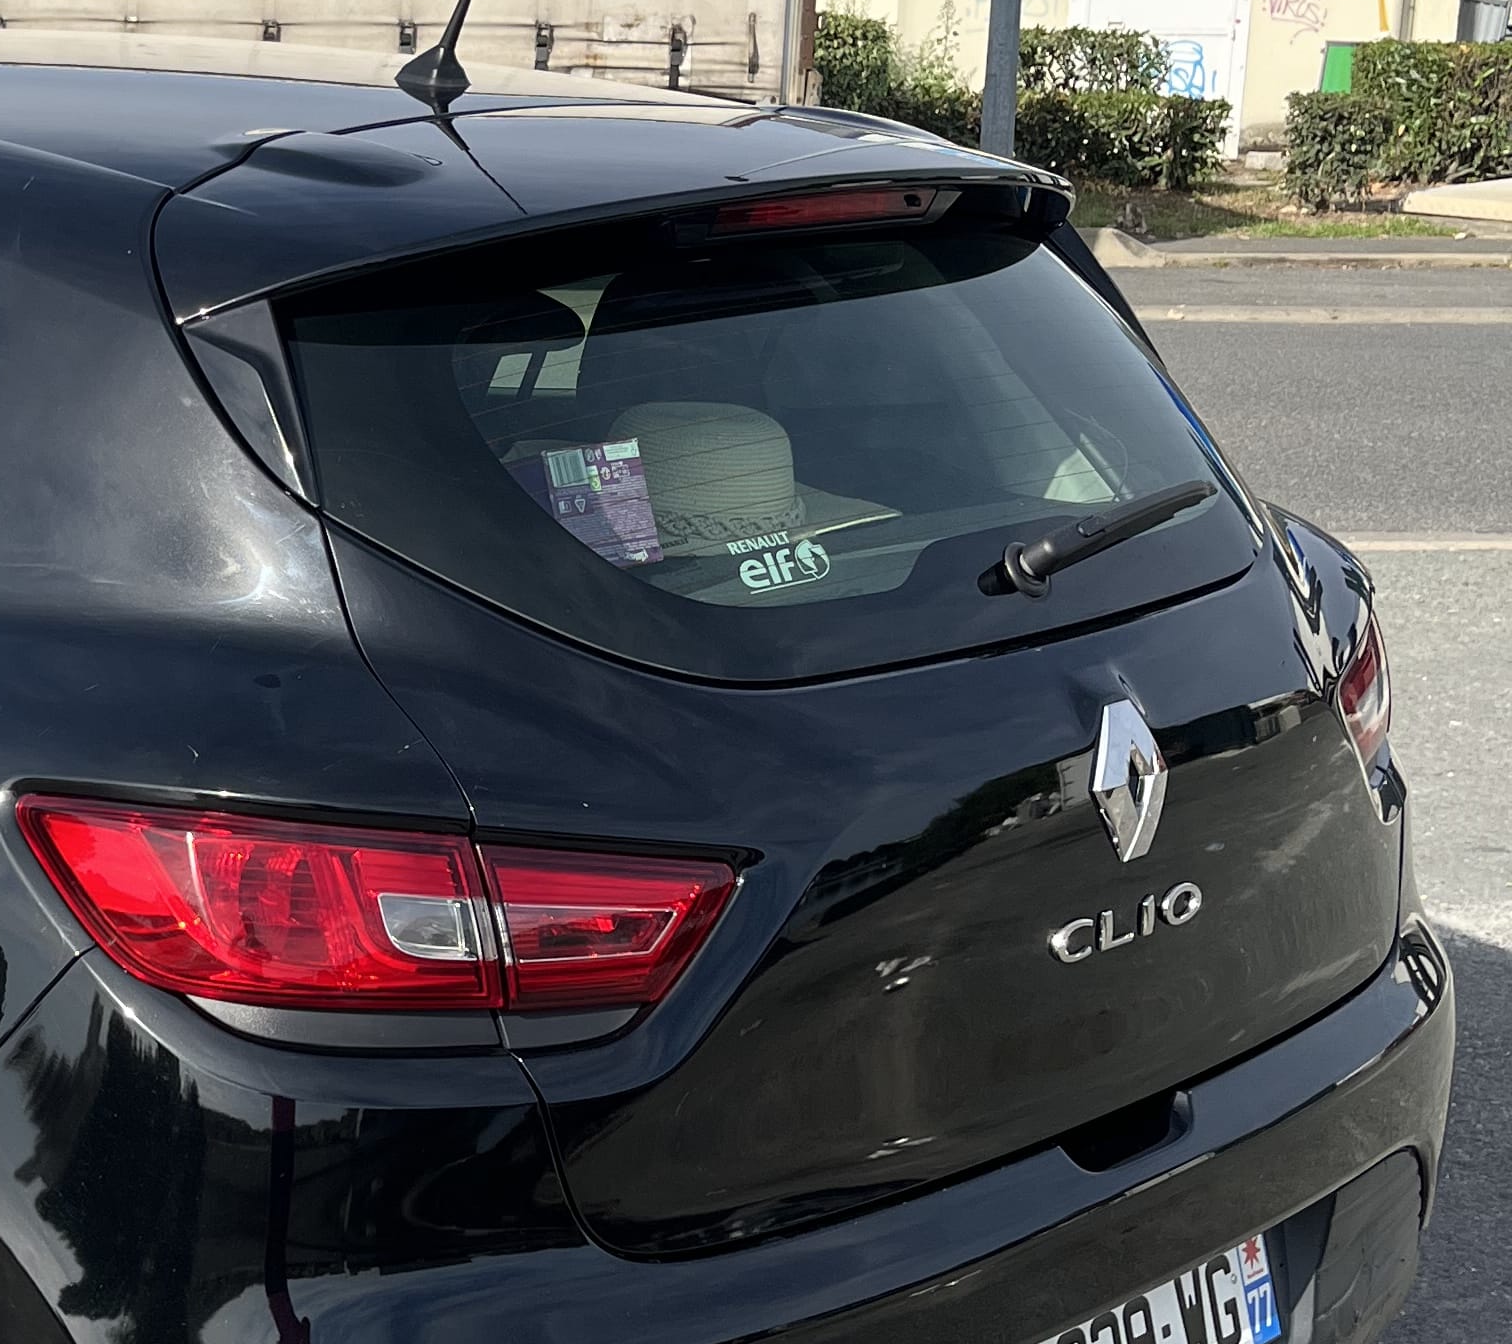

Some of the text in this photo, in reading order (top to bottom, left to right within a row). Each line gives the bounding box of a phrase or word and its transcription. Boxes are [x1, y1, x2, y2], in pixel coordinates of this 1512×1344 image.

[726, 531, 790, 556] RENAULT
[739, 548, 795, 589] elf
[1047, 881, 1203, 964] CLIO
[1247, 1281, 1273, 1334] 77
